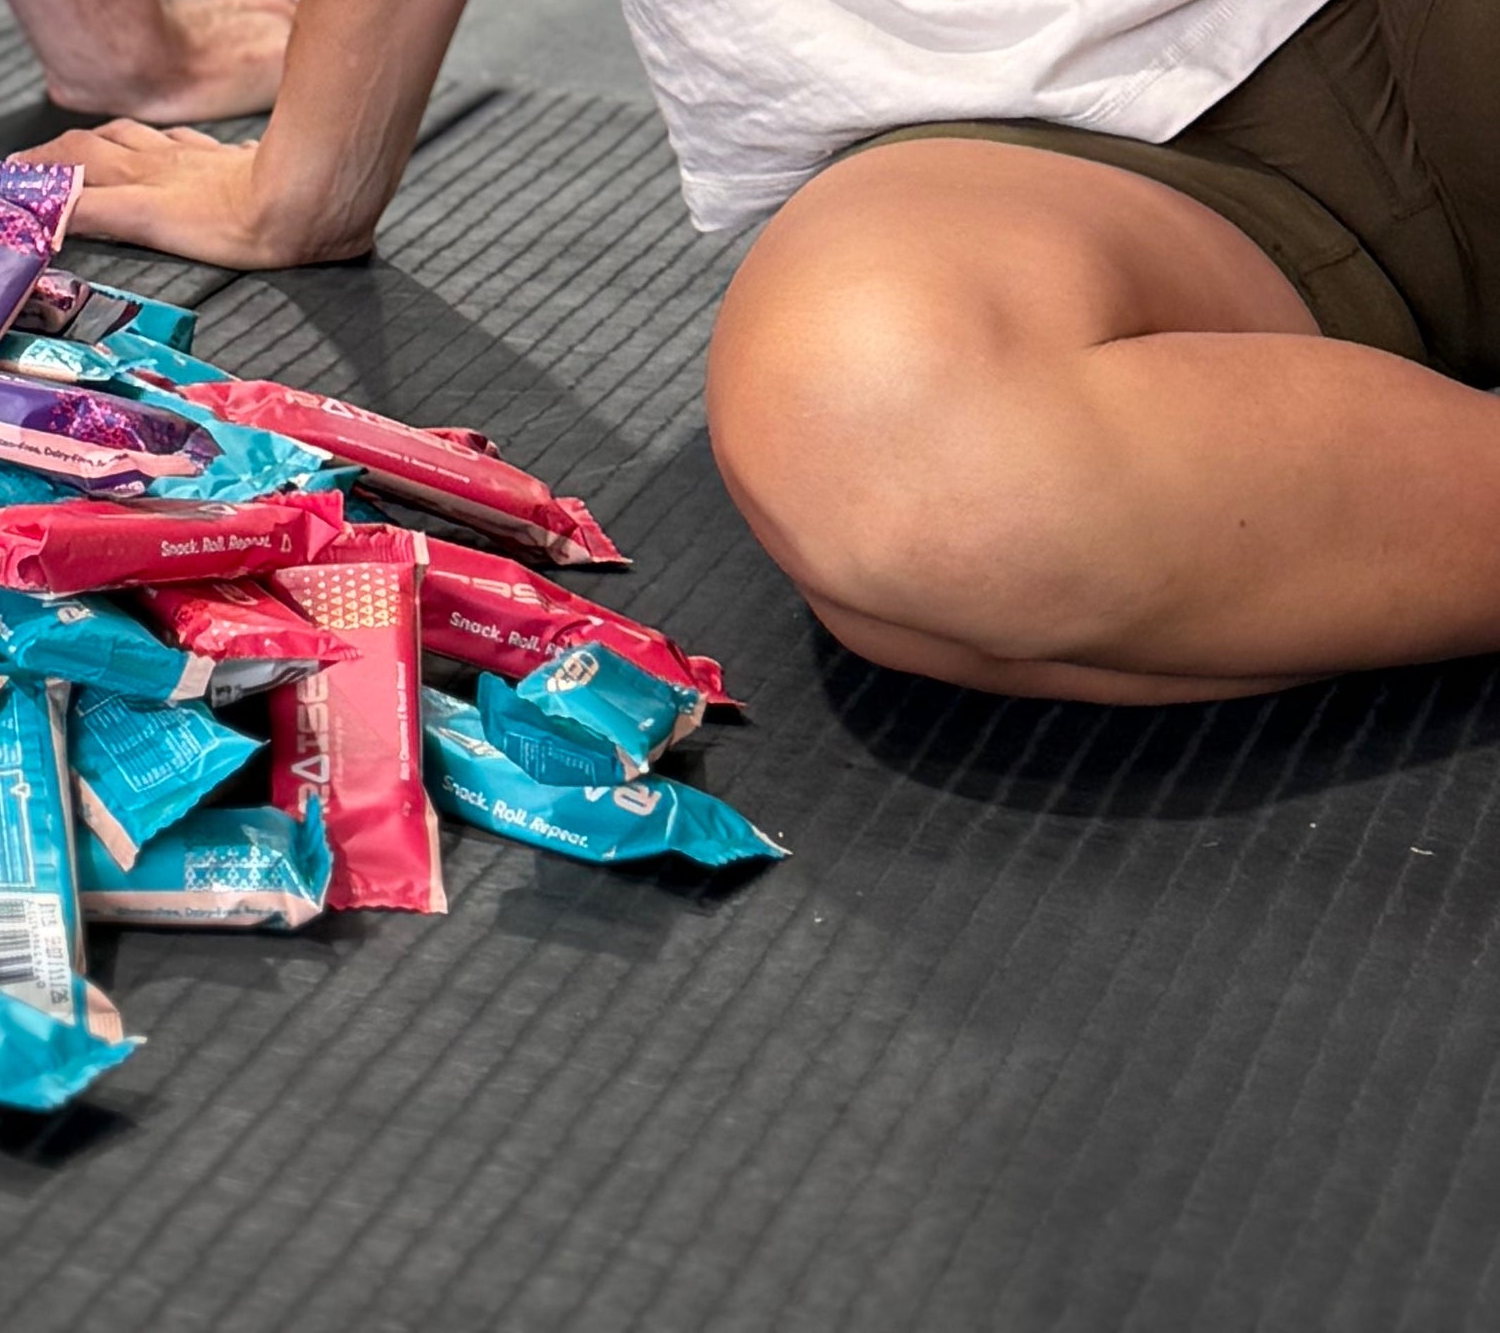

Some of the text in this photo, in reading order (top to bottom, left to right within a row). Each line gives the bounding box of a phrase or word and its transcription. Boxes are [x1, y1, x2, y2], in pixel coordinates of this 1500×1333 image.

[449, 611, 504, 644] Snack.
[507, 630, 541, 654] Roll.
[441, 774, 489, 812] Snack.
[492, 799, 527, 827] Roll.
